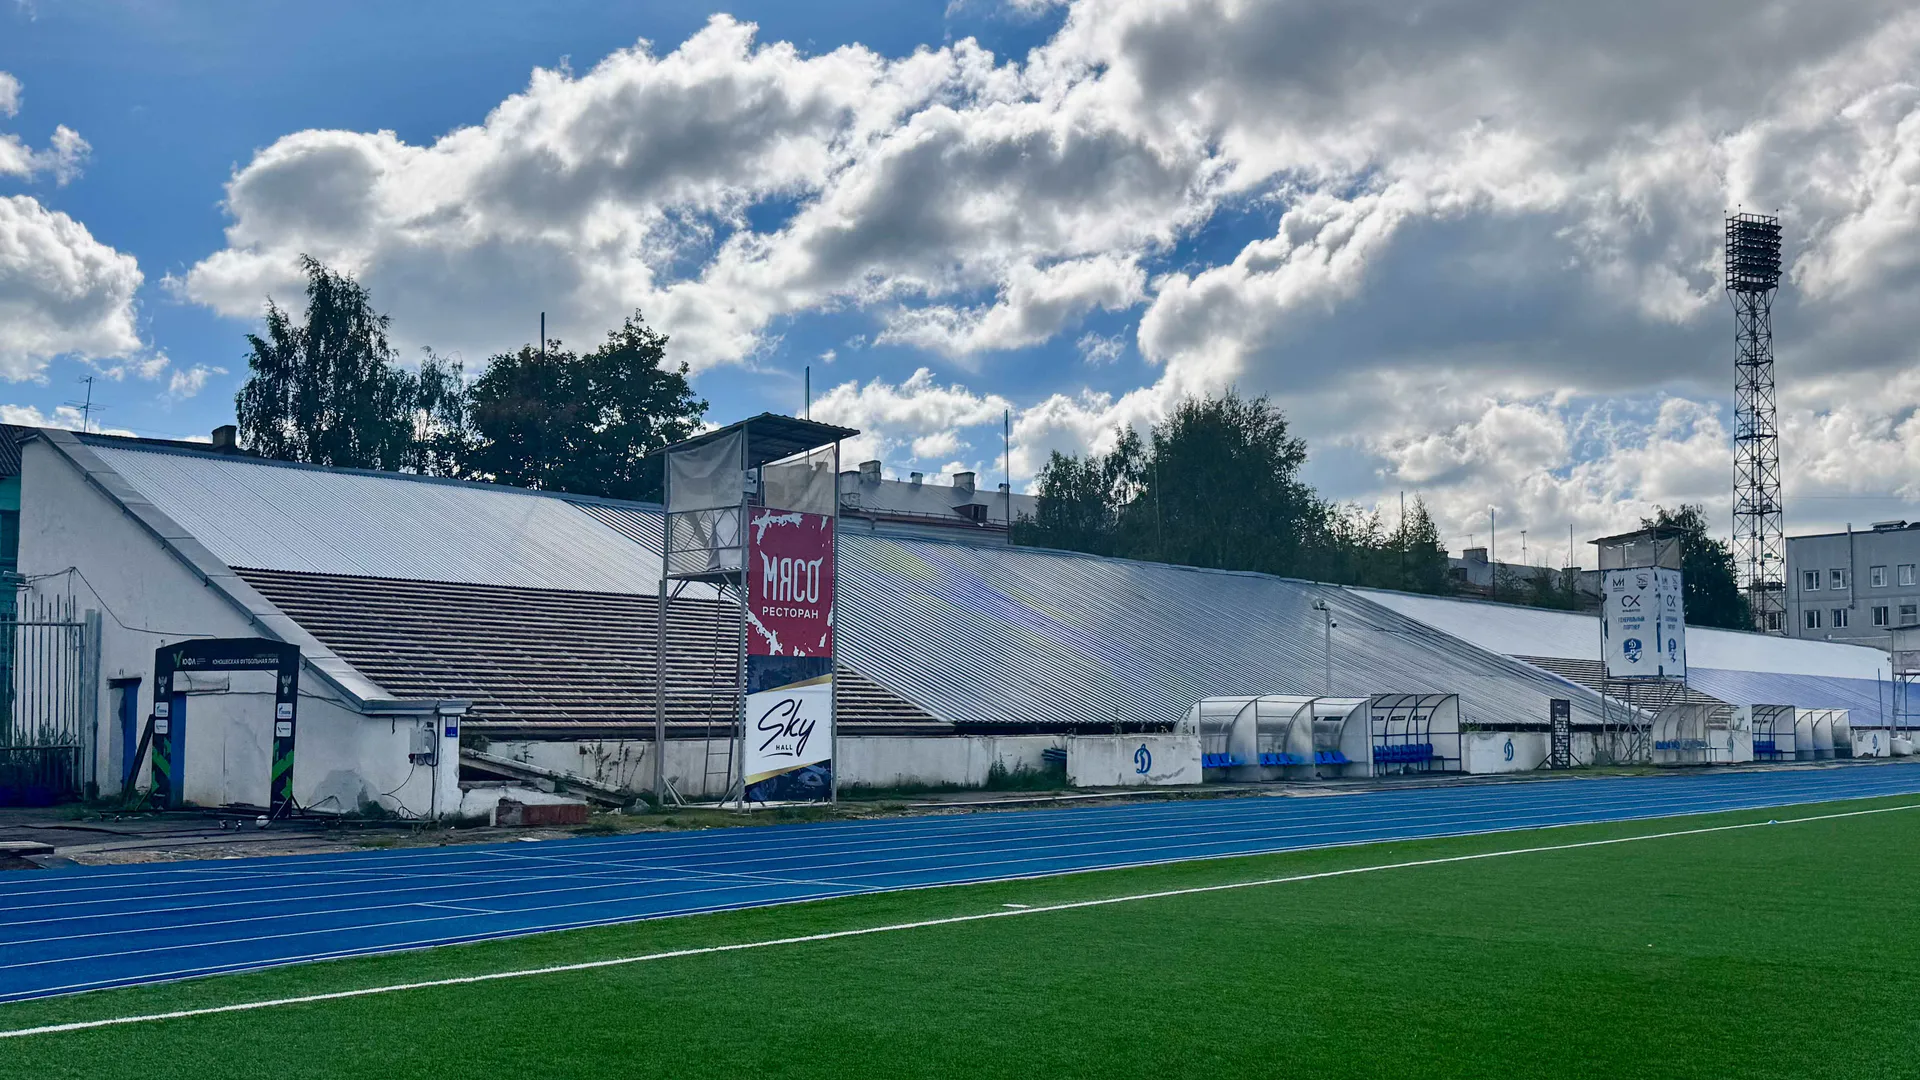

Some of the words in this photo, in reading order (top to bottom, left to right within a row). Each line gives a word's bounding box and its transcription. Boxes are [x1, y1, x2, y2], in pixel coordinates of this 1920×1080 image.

[760, 550, 823, 603] МЯСО
[762, 606, 819, 619] РЕСТОРАН
[758, 698, 816, 757] Sky
